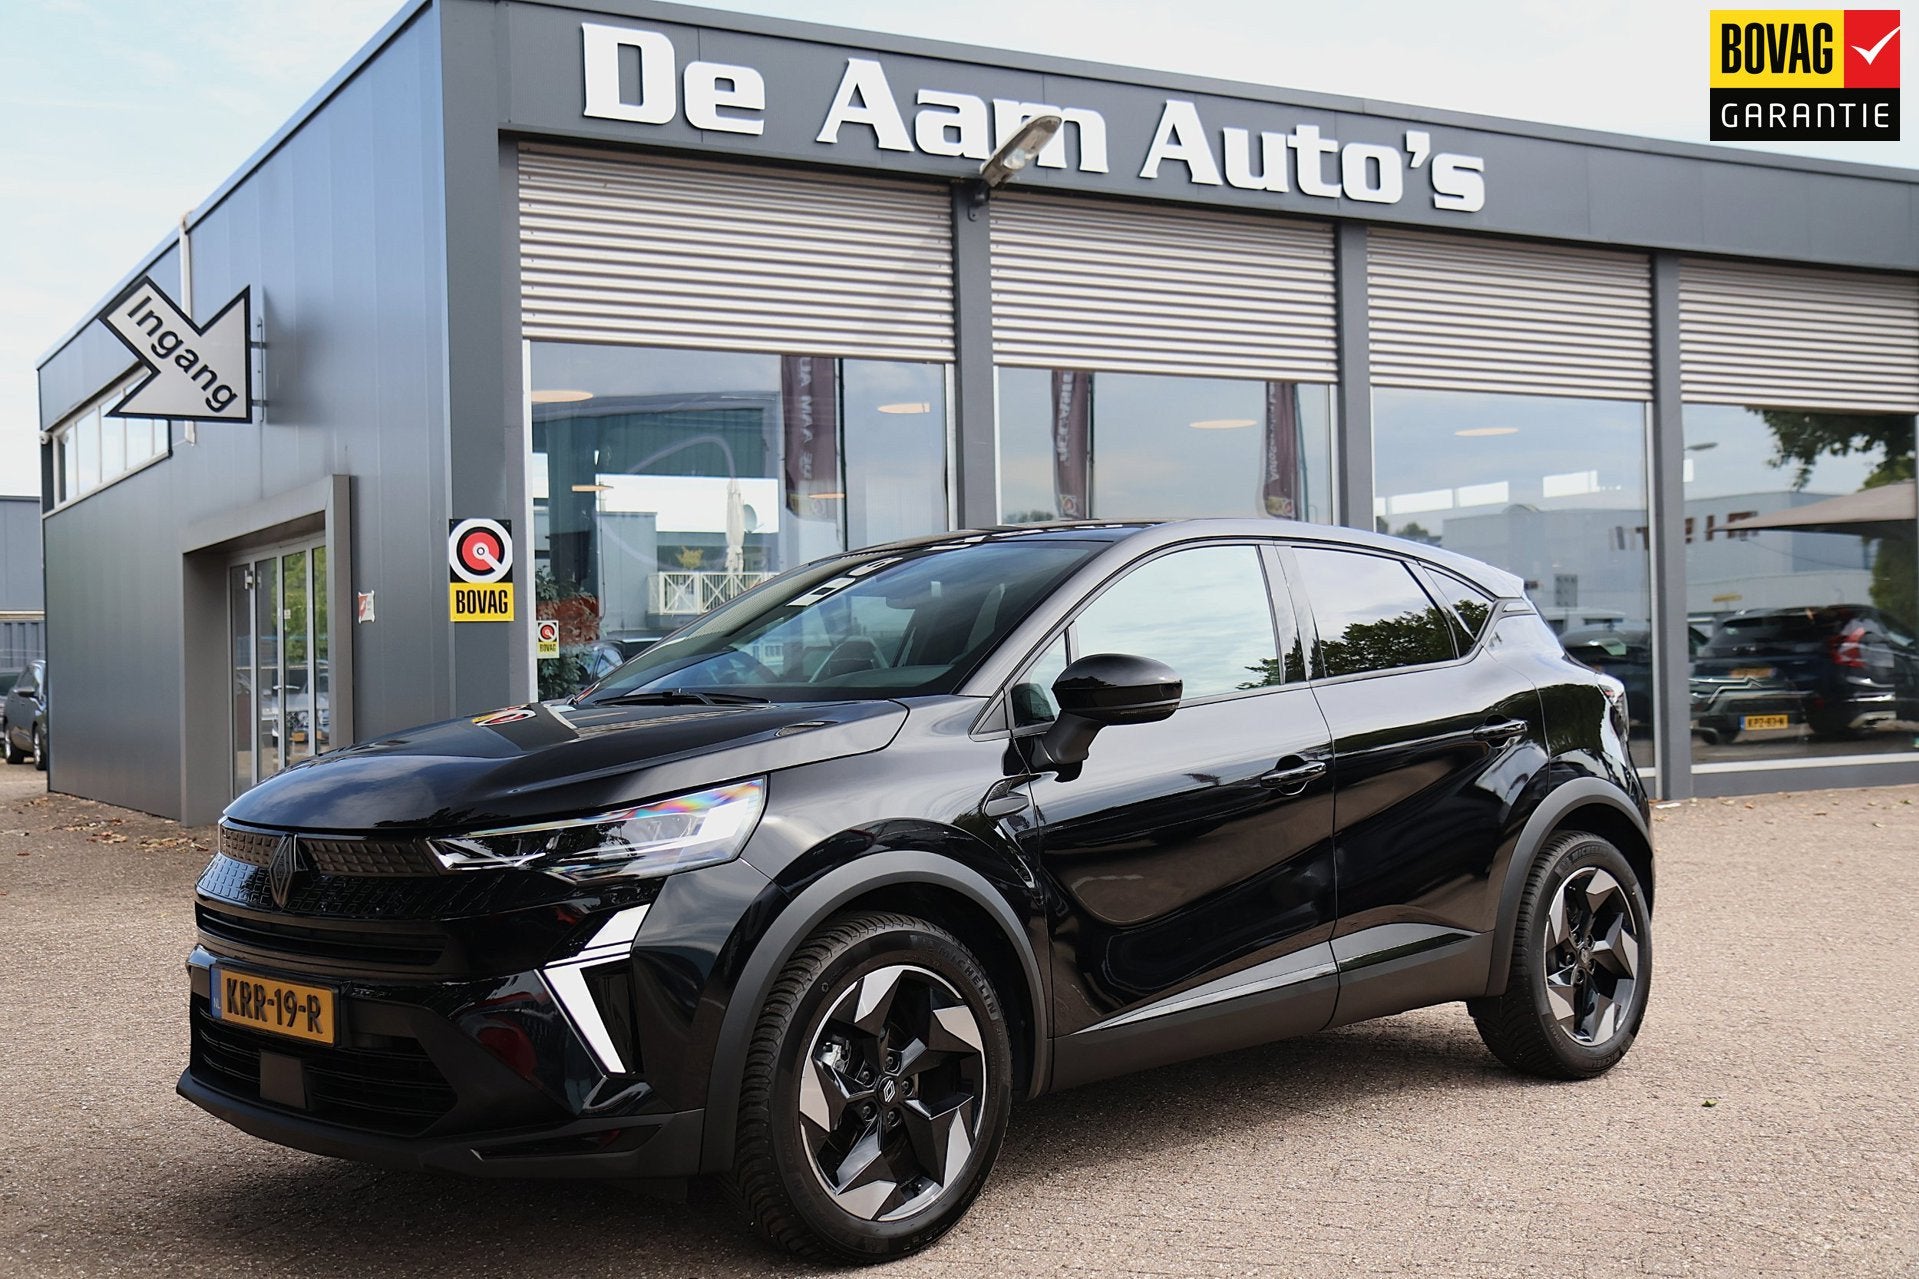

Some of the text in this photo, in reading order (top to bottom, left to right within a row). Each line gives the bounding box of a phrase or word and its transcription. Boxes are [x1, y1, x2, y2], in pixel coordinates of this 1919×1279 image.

[581, 22, 1486, 213] De Aam Auto's
[127, 295, 239, 413] Ingang
[455, 589, 508, 614] BOVAG
[226, 977, 324, 1035] KRR-19-R
[938, 946, 999, 1016] MICHELIN
